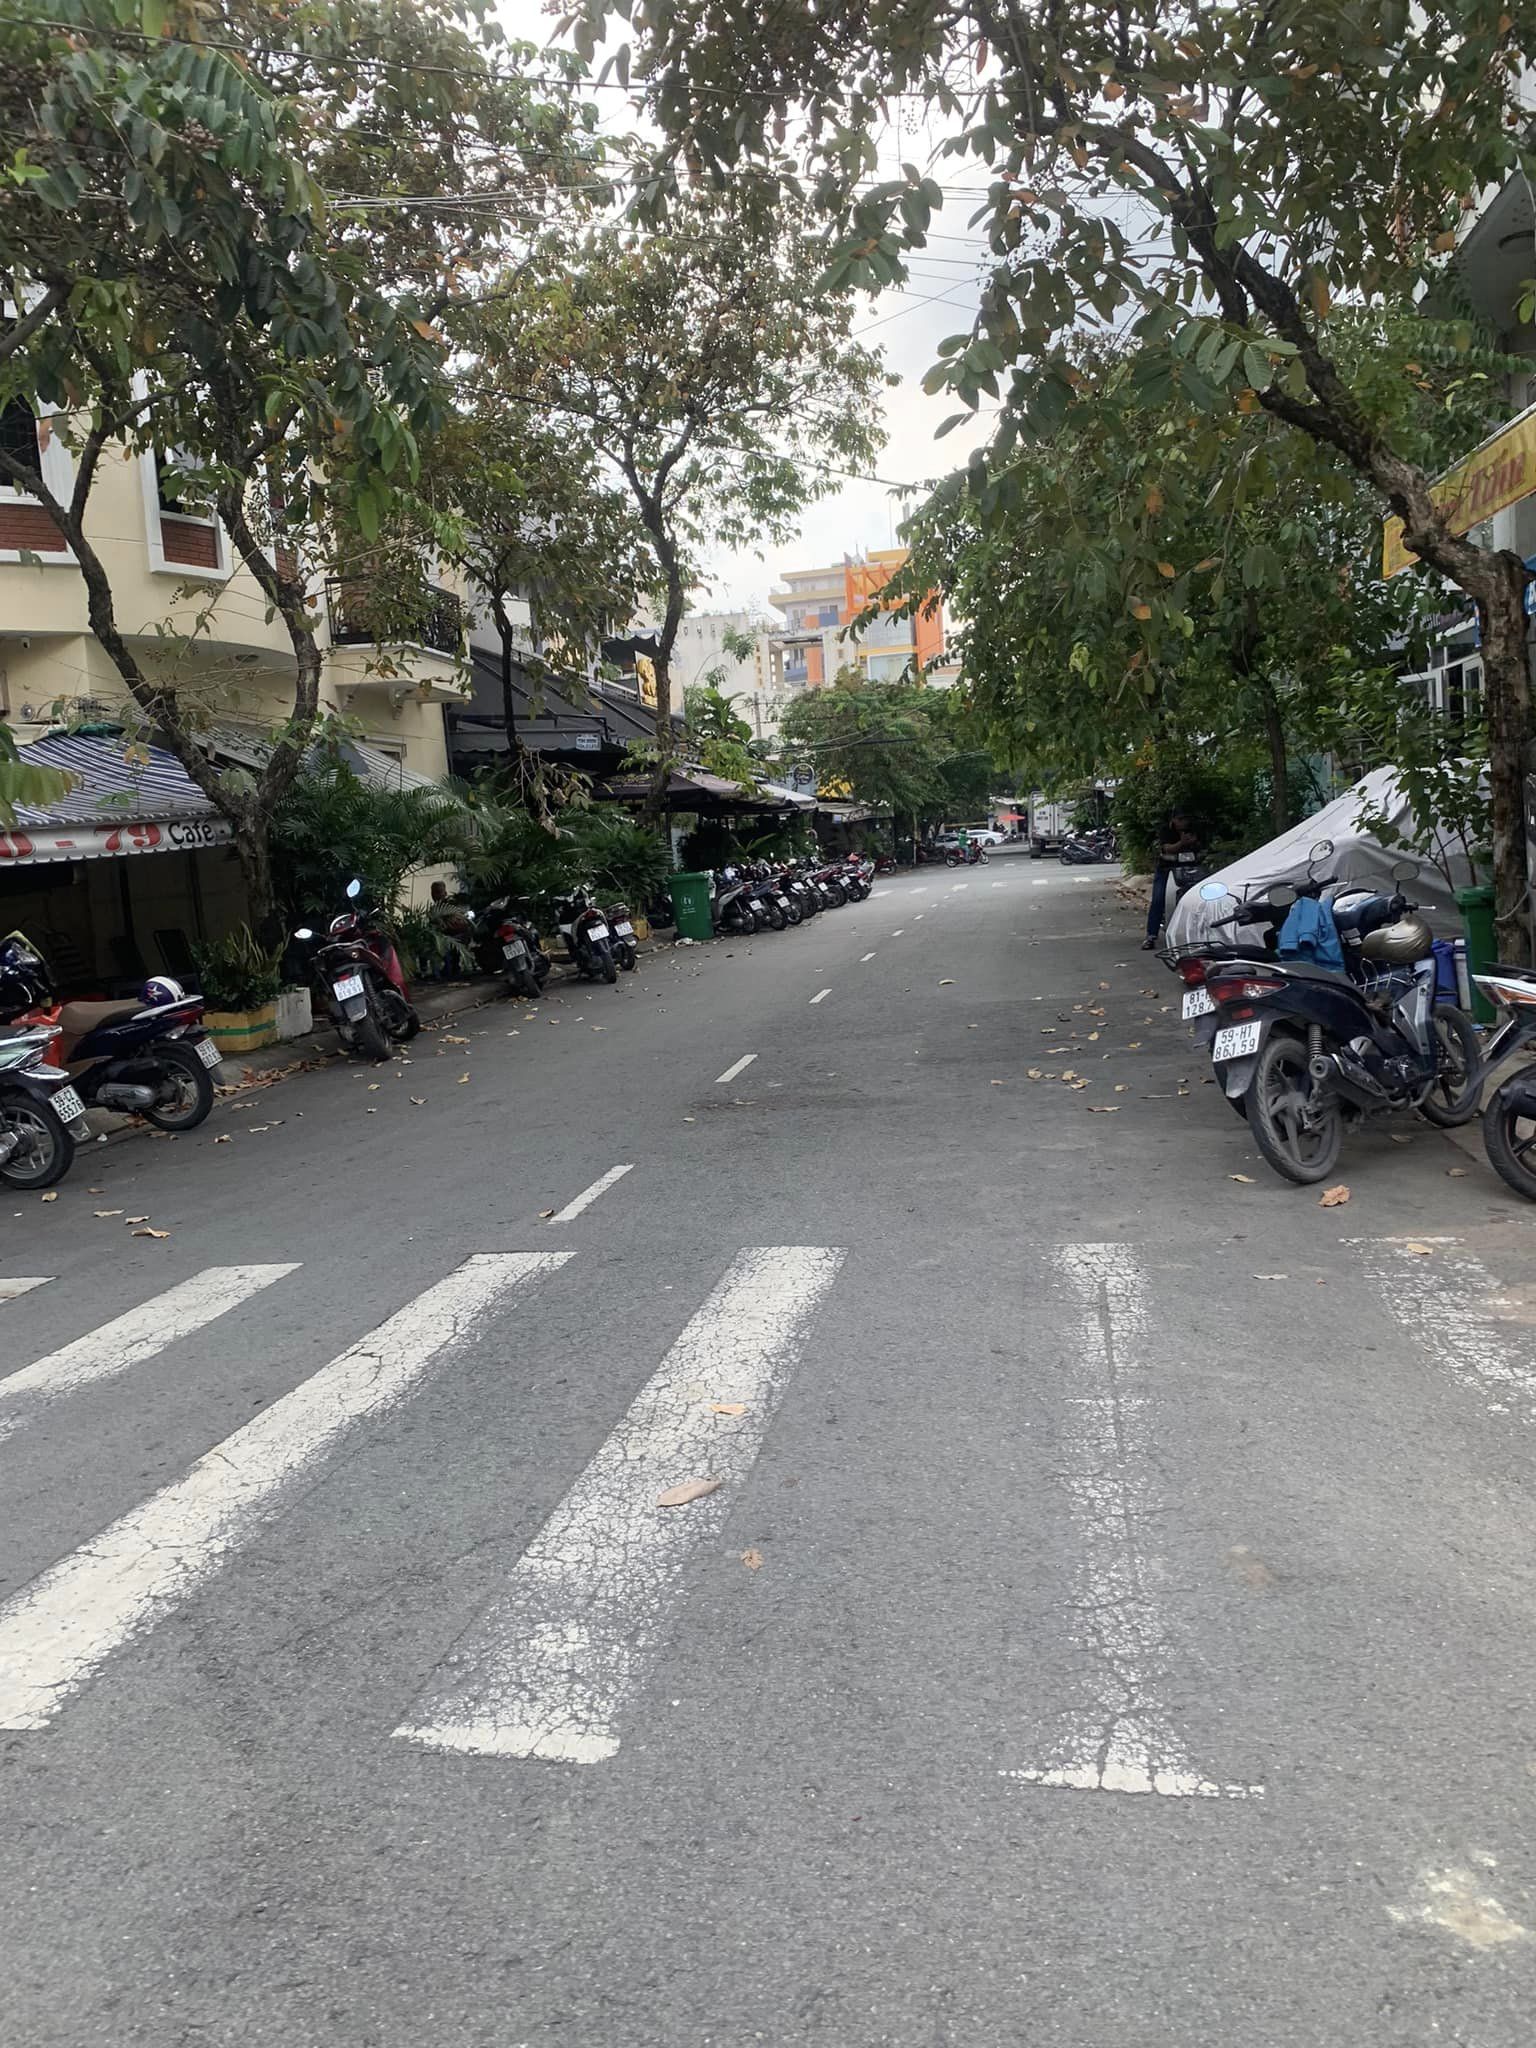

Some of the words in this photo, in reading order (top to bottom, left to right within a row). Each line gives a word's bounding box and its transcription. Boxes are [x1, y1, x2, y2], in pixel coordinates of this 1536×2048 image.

[94, 823, 162, 851] 79
[168, 819, 214, 845] Café
[1221, 1025, 1252, 1044] 59-H1
[1215, 1038, 1256, 1060] 861.59
